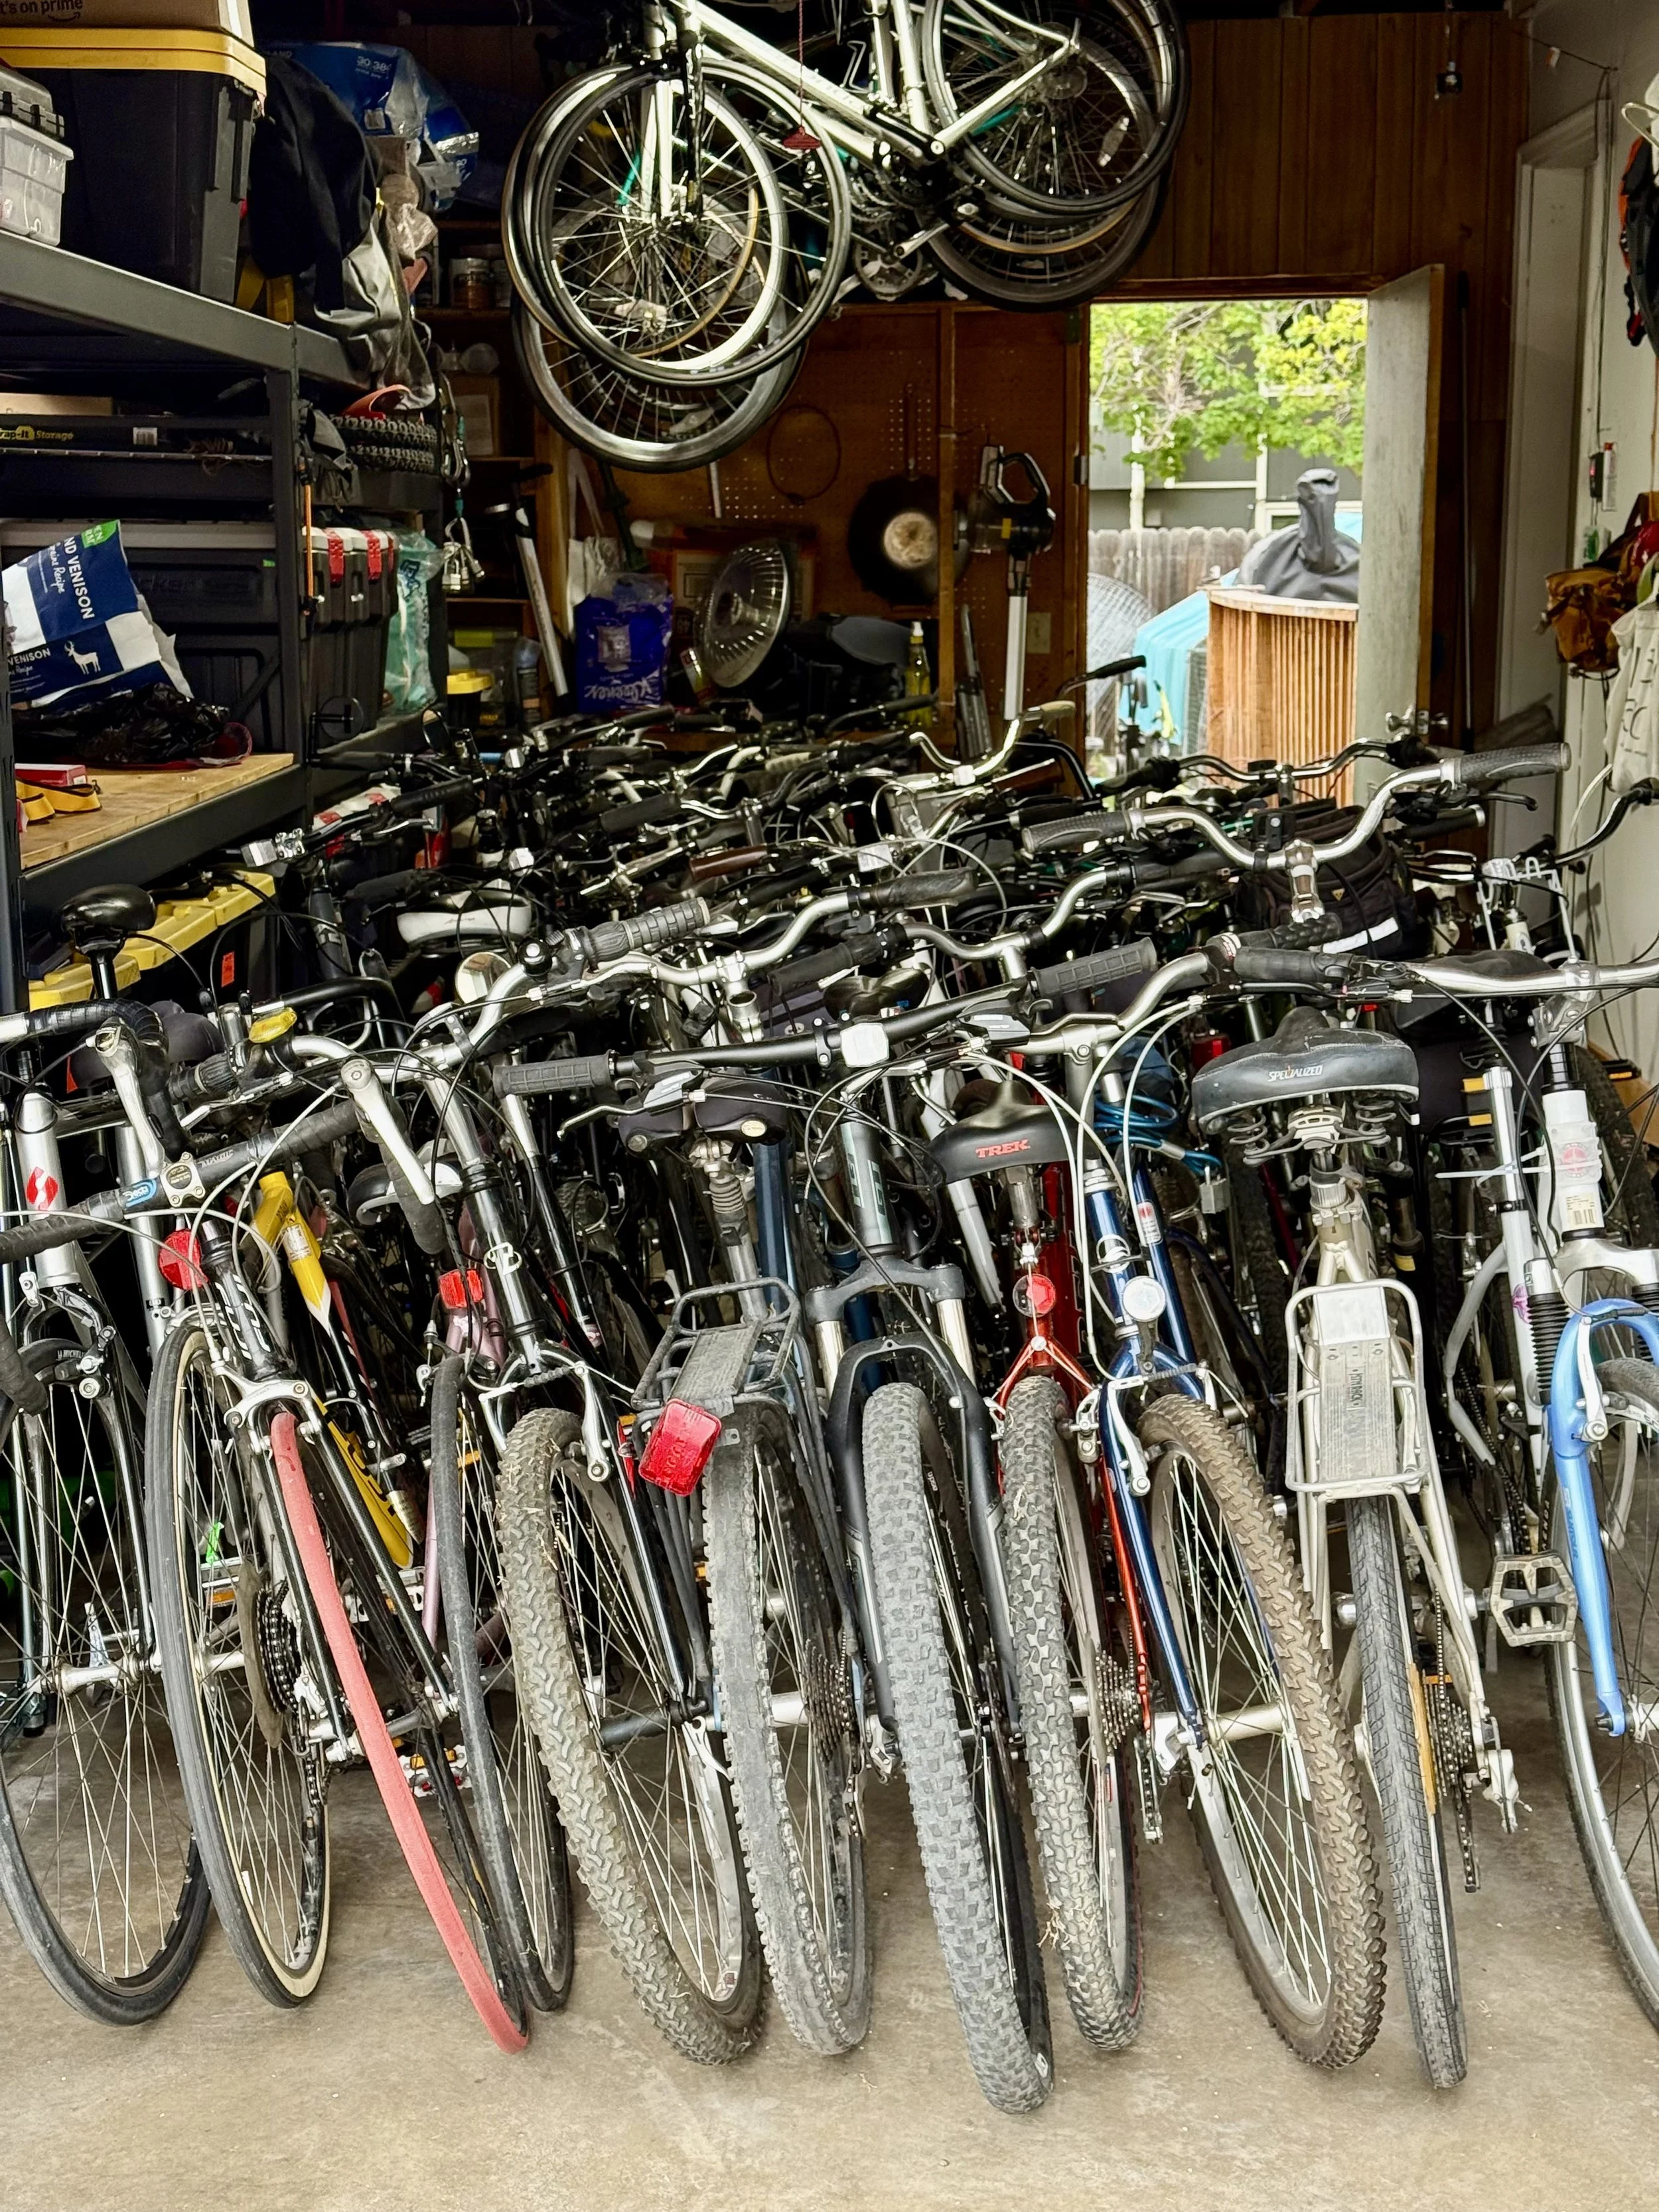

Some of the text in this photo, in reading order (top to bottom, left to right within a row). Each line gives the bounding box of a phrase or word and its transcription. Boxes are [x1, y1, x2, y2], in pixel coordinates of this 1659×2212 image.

[19, 2, 38, 13] on
[41, 0, 83, 15] prime
[36, 430, 74, 441] Storage
[67, 555, 96, 619] VENISON
[8, 648, 51, 665] VENISON
[584, 678, 657, 703] Kleenex
[1267, 1065, 1323, 1082] SPECIALIZED
[975, 1139, 1031, 1158] TREK
[214, 1282, 252, 1361] FUJI
